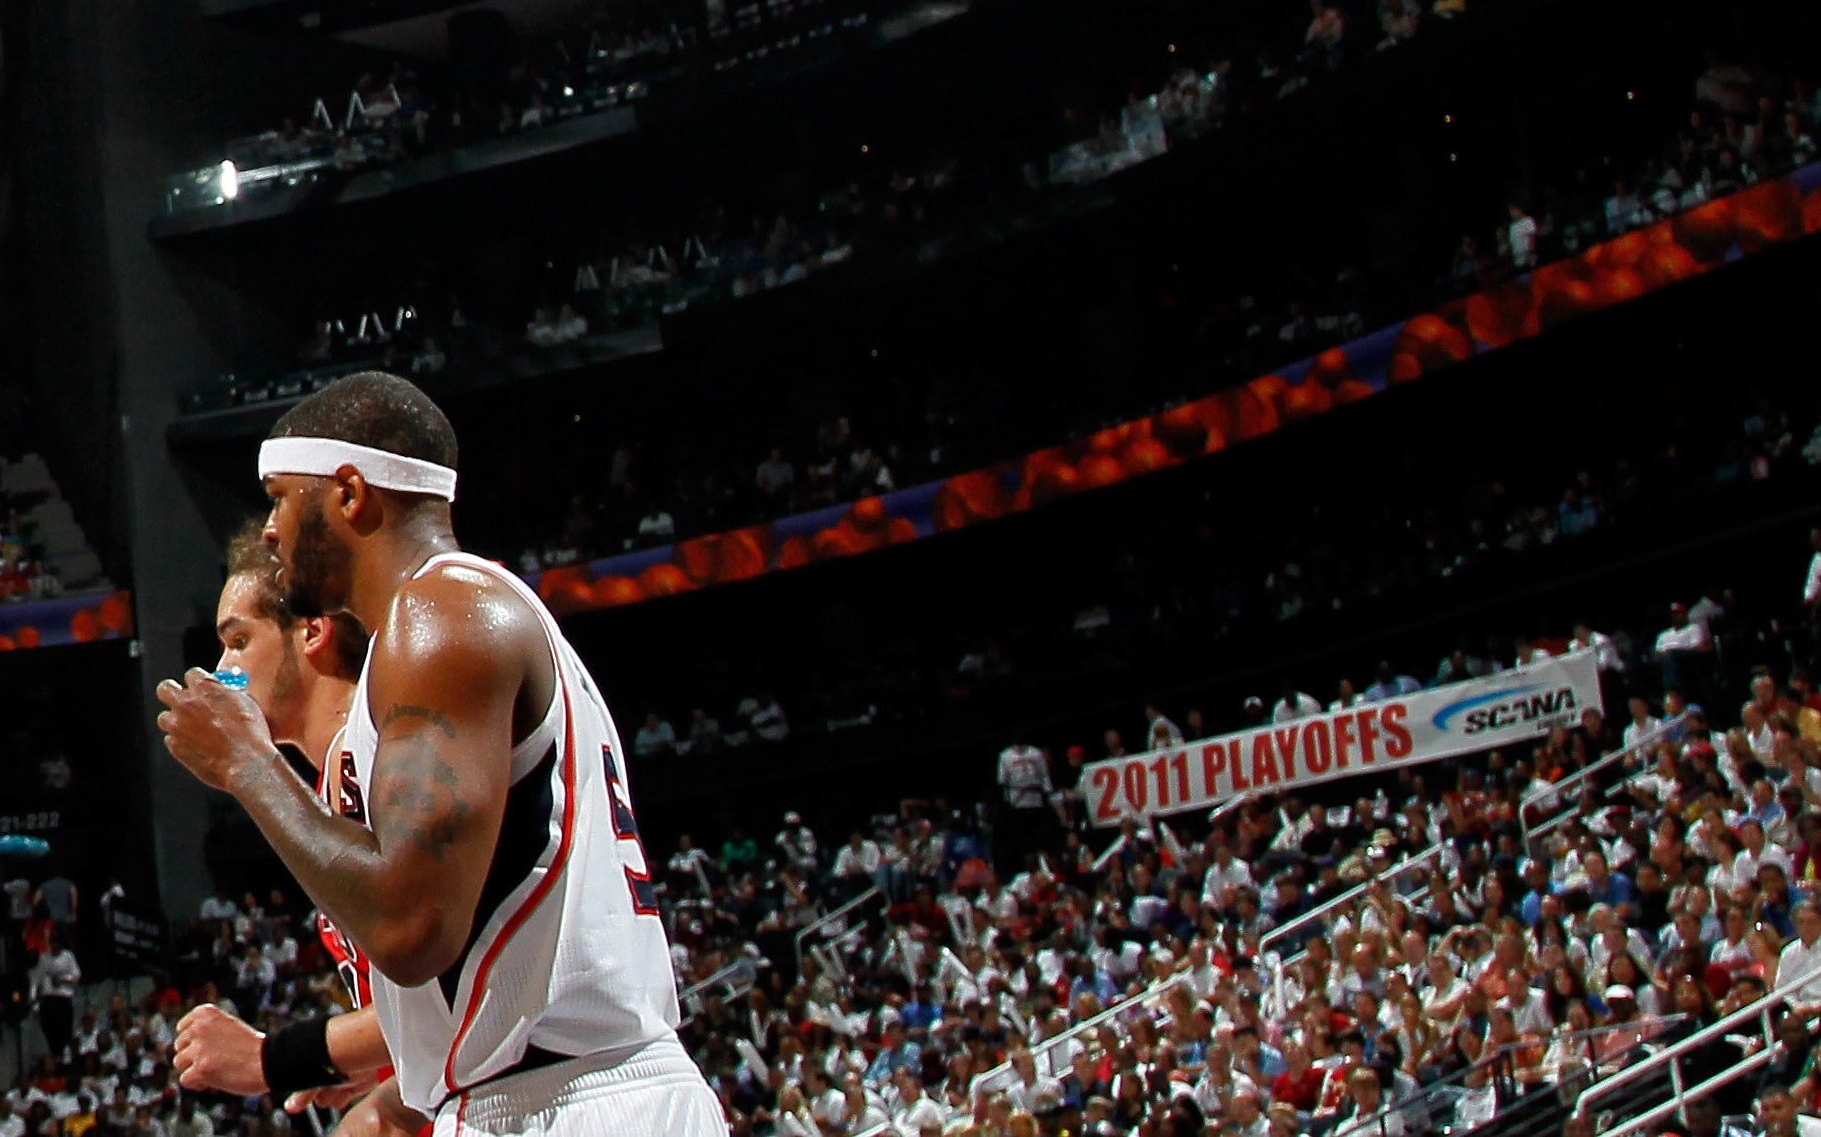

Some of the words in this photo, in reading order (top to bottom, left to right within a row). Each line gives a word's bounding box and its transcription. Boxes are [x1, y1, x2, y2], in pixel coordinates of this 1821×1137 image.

[1464, 686, 1576, 735] SCANA
[1092, 752, 1190, 823] 2011
[1202, 703, 1414, 799] PLAYOFFS
